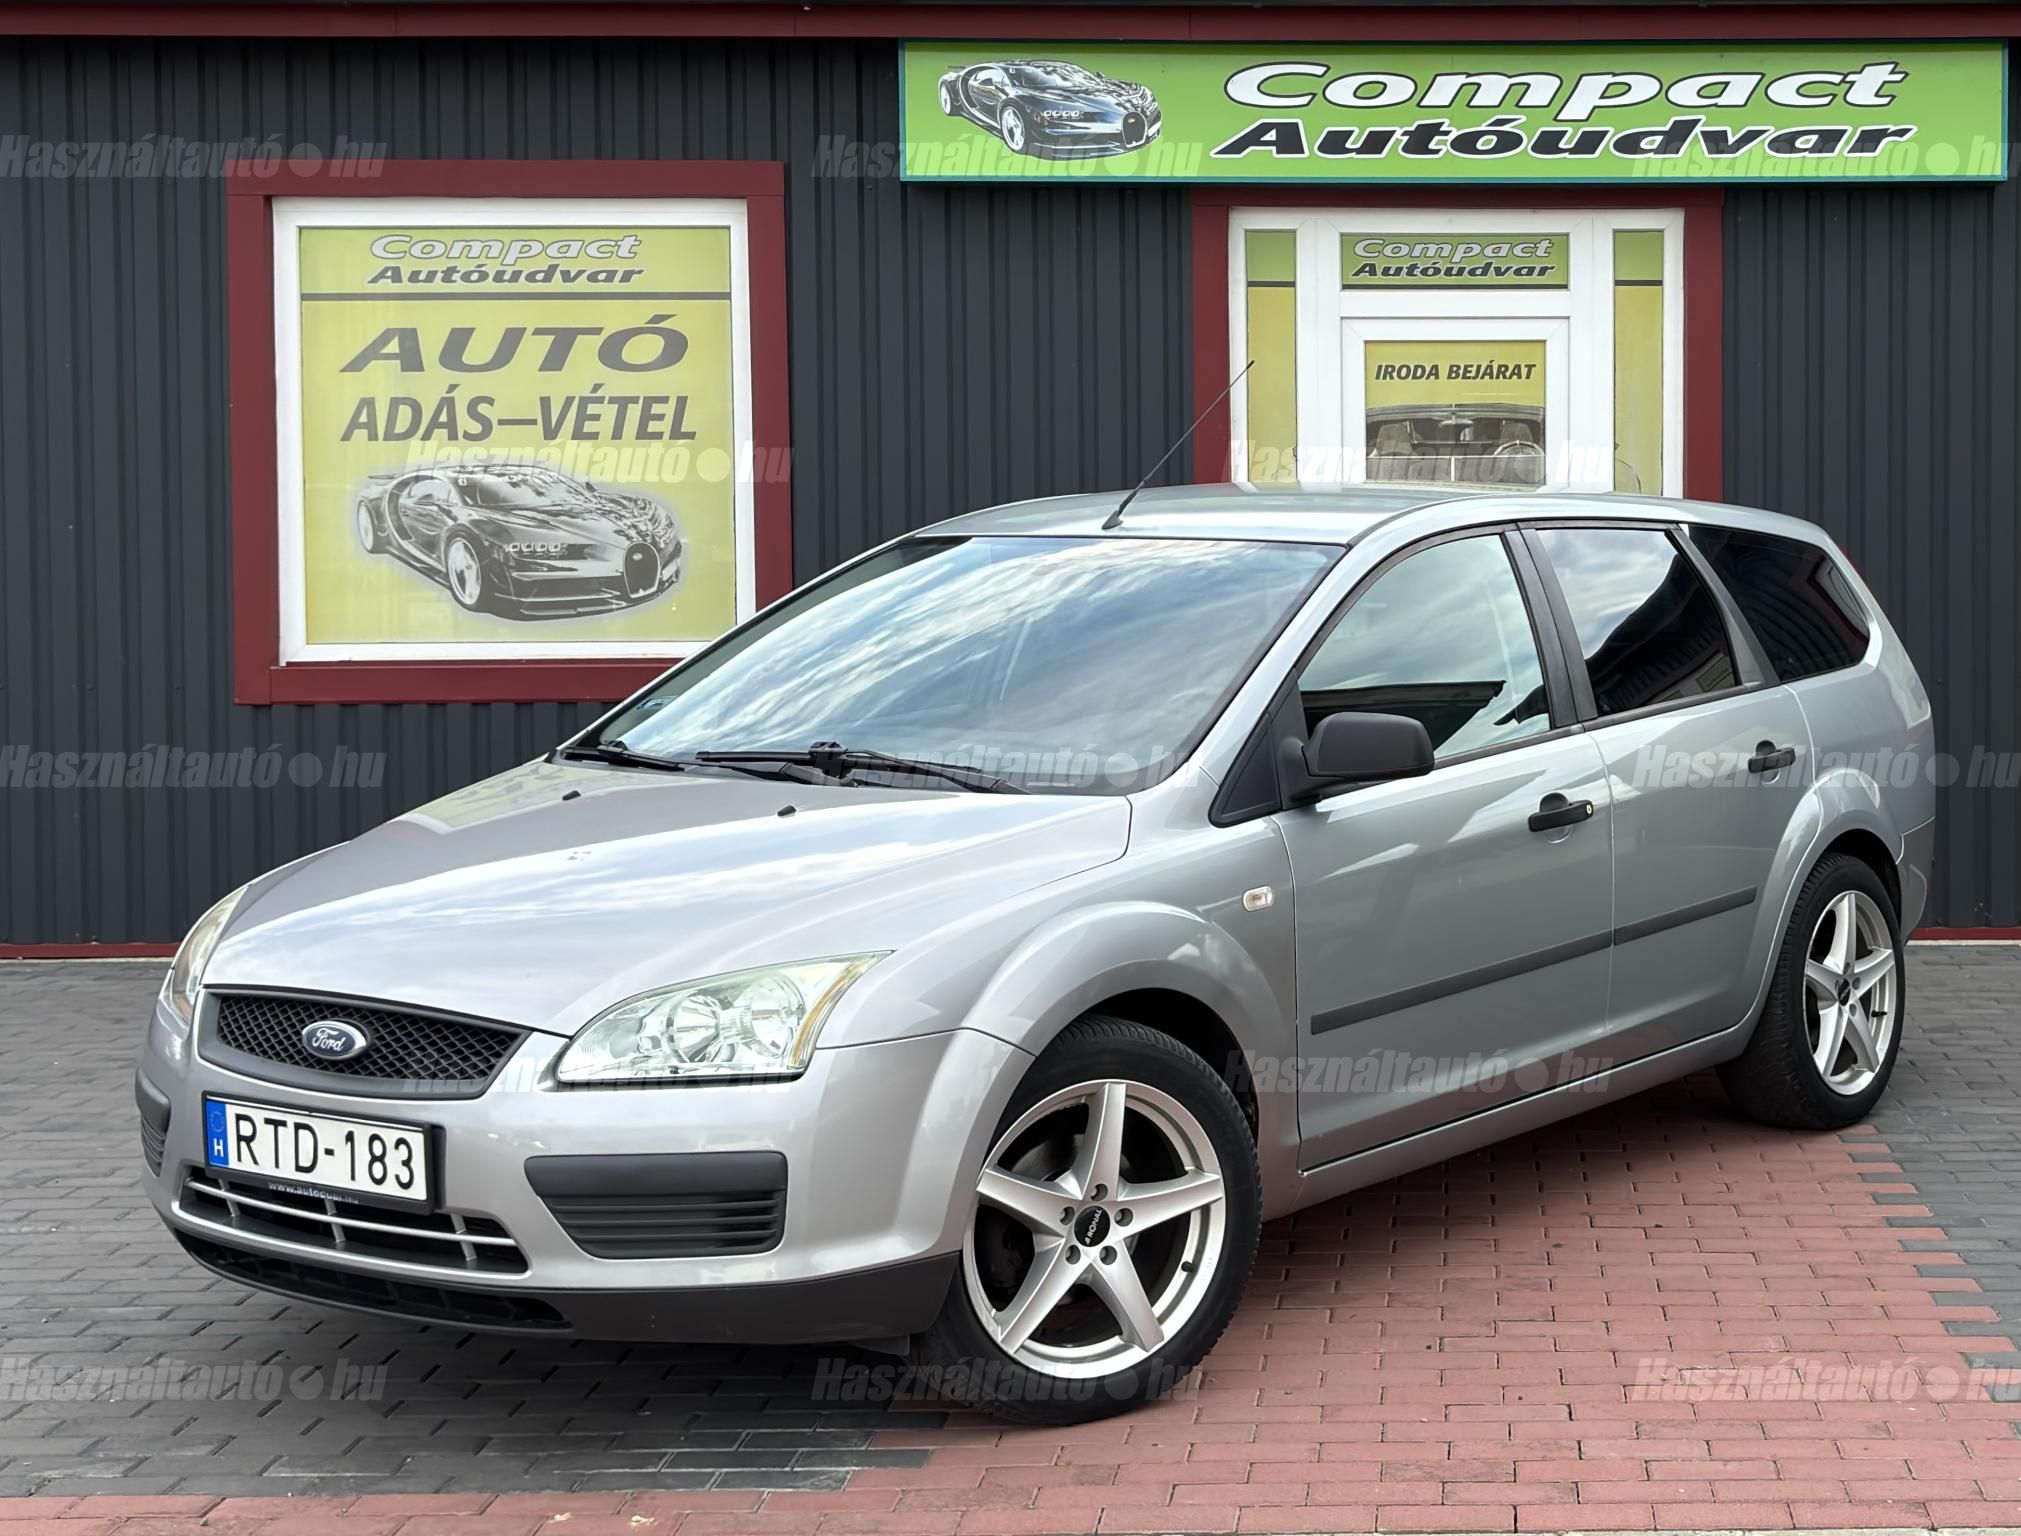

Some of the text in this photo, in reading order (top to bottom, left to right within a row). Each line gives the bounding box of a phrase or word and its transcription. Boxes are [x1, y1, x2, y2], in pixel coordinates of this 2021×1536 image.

[1224, 61, 1908, 122] Compact
[1211, 115, 1916, 159] Autóudvar
[370, 234, 642, 266] Compact
[1353, 238, 1555, 263] Compact
[366, 264, 644, 284] Autóudvar
[1351, 261, 1556, 278] Autóudvar
[339, 314, 689, 373] AUTÓ
[1375, 360, 1536, 380] IRODA BEJÁRAT
[312, 1028, 344, 1051] Ford
[213, 1138, 224, 1158] H
[234, 1113, 414, 1190] RTD-183
[1086, 1209, 1103, 1239] RONAL
